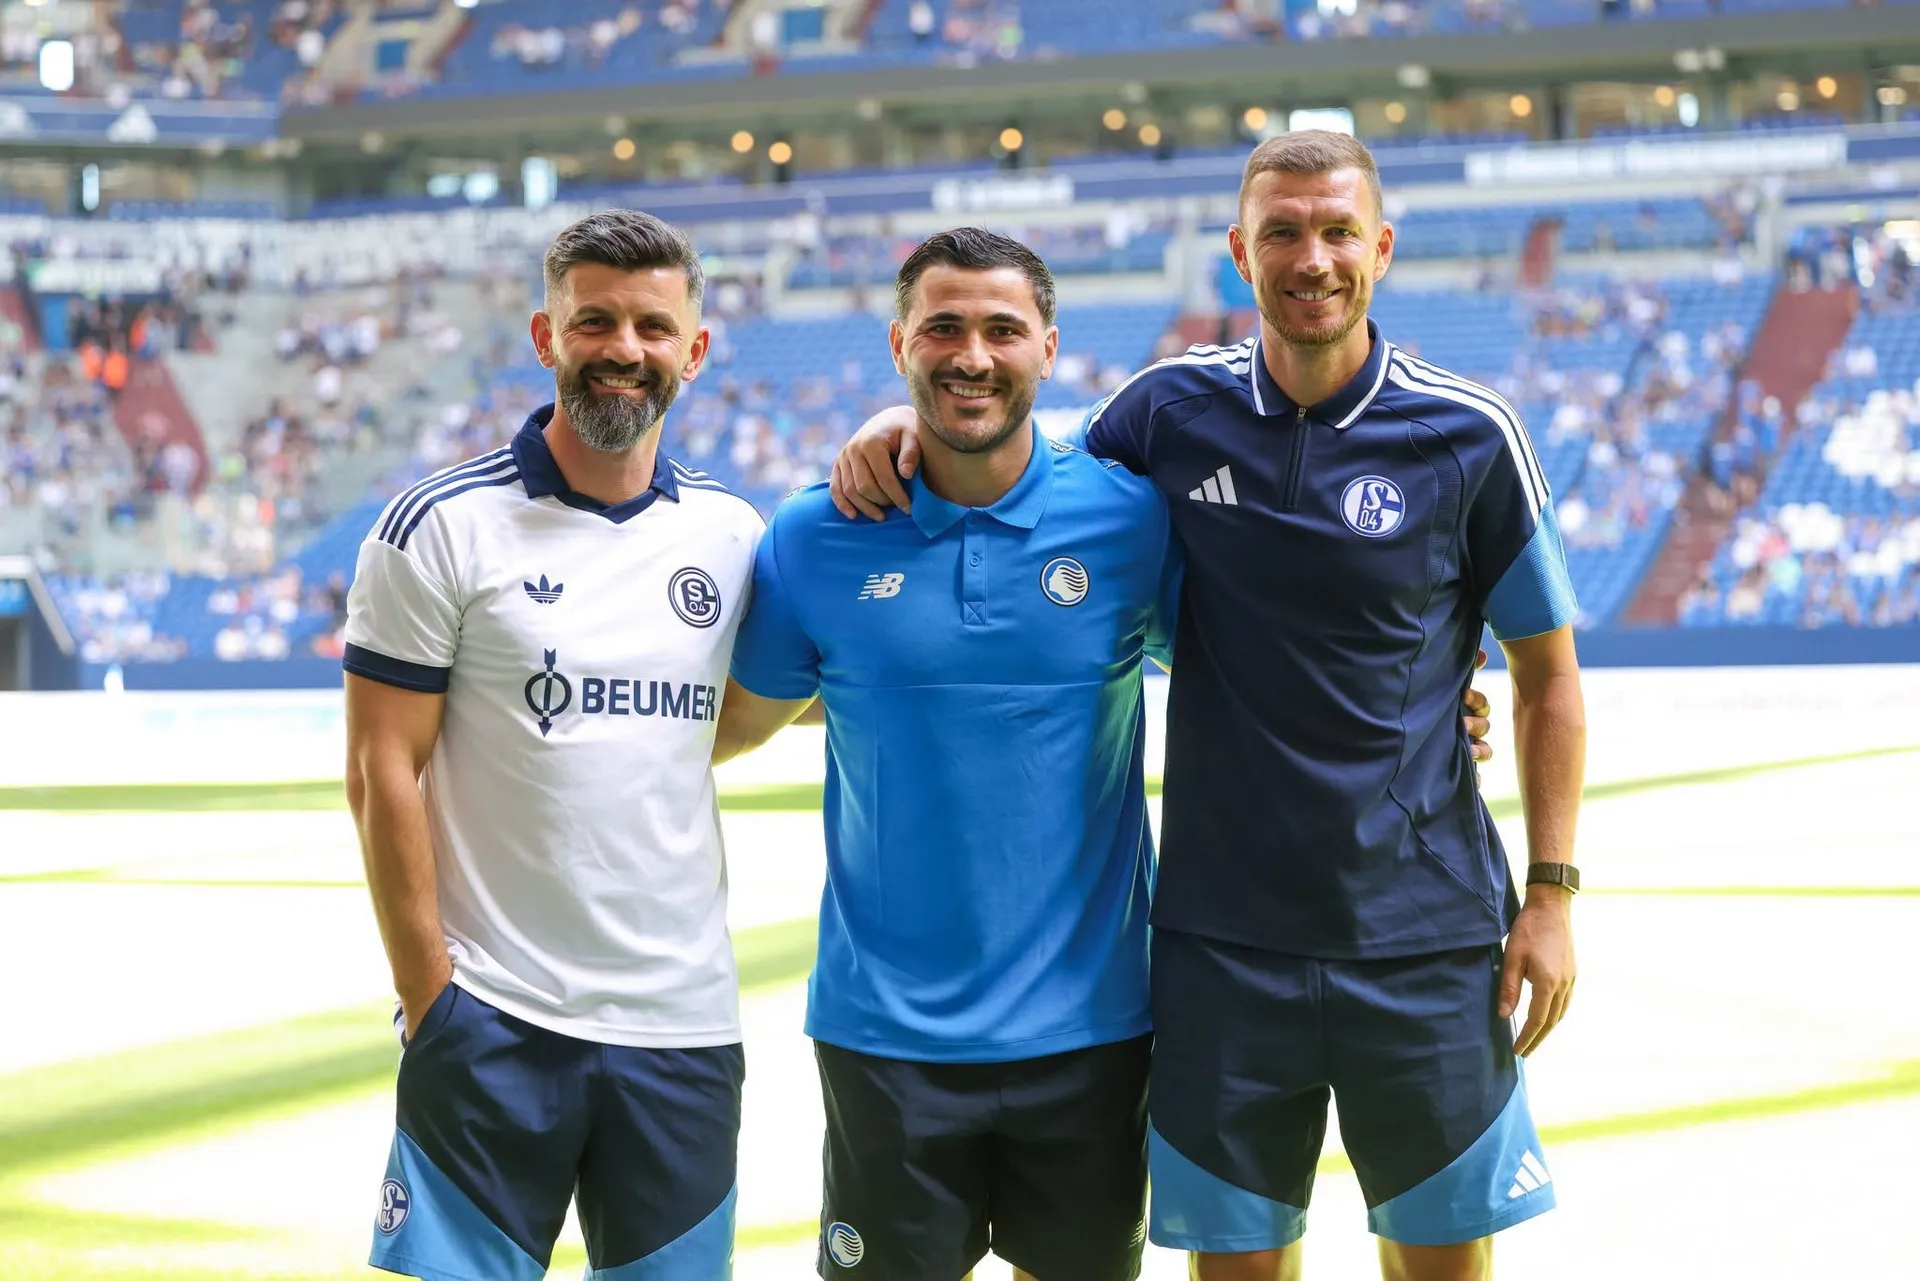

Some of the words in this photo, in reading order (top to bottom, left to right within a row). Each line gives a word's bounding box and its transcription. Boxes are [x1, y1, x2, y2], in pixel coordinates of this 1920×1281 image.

[1359, 510, 1378, 530] 04
[857, 572, 906, 600] NB
[687, 601, 706, 613] 04
[582, 677, 716, 722] BEUMER
